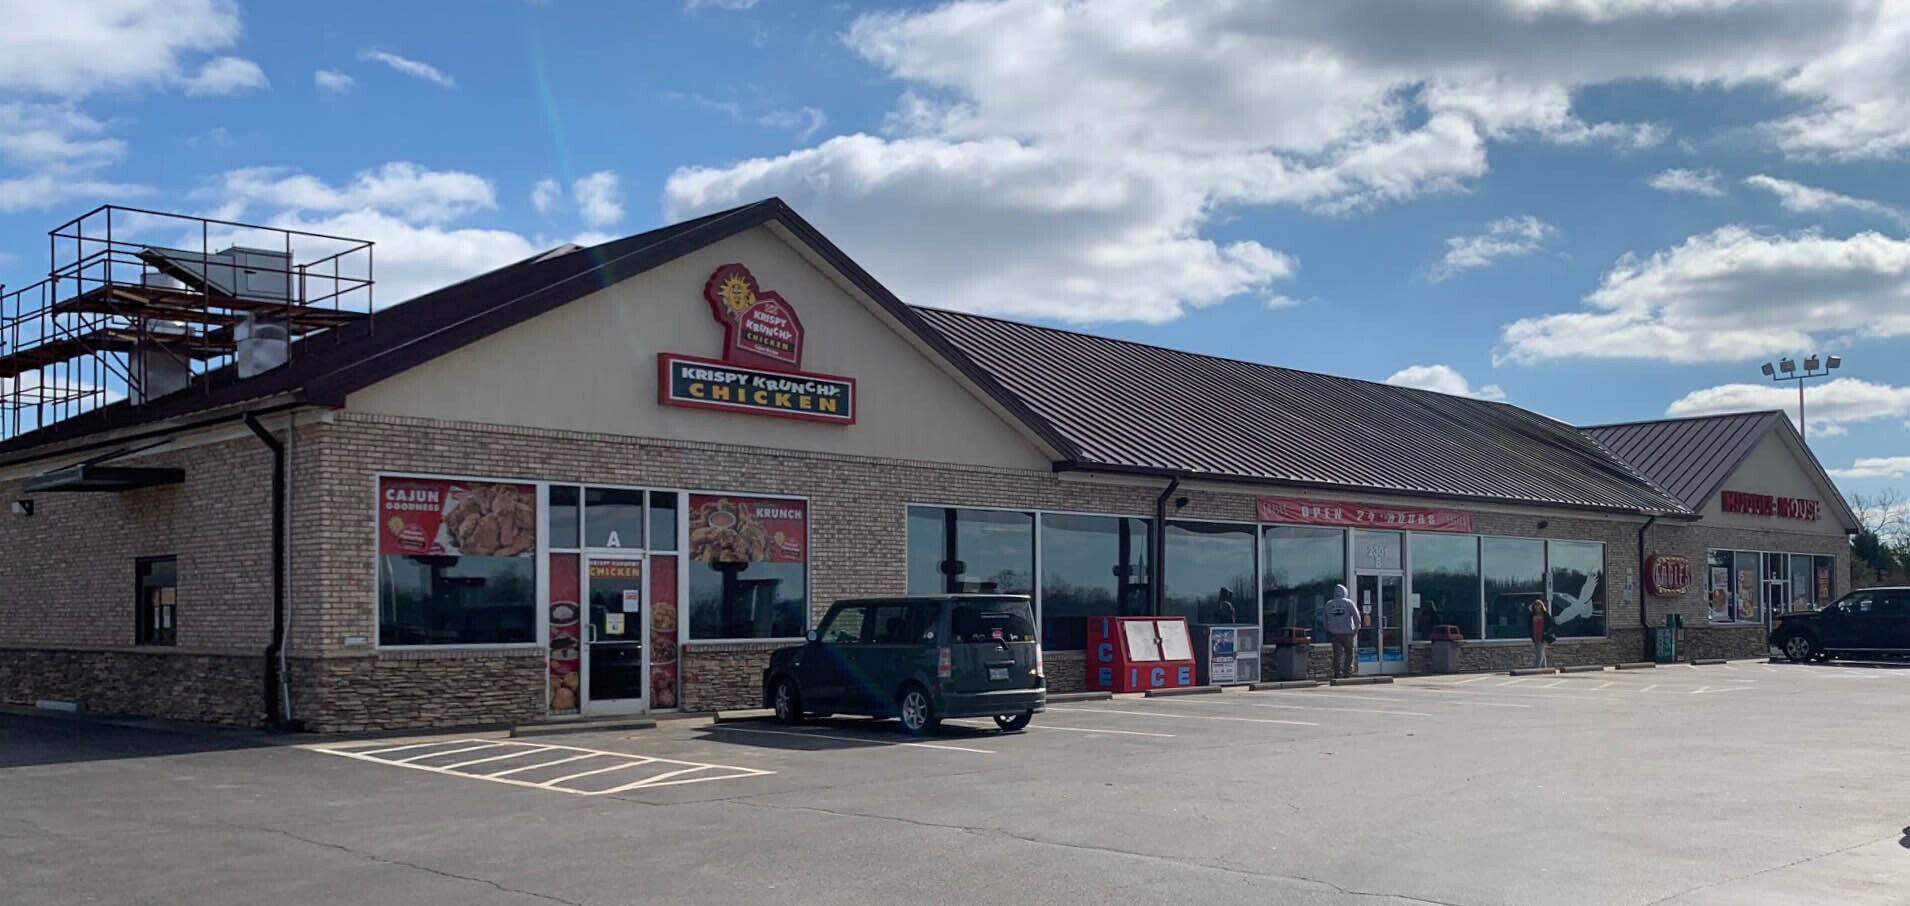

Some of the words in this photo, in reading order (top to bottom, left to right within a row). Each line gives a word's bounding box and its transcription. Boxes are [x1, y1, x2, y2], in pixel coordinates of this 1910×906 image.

[754, 310, 787, 327] KRISPY
[746, 320, 792, 340] KRUNCHY
[747, 333, 790, 350] CHICKEN
[681, 367, 749, 386] KRISPY
[752, 375, 840, 397] KRUNCHY
[689, 383, 836, 412] CHICKEN
[385, 489, 439, 502] CAJUN
[385, 501, 440, 512] GOODNESS
[756, 508, 802, 519] KRUNCH
[1301, 506, 1342, 520] OPEN
[1356, 510, 1375, 522] 24
[606, 530, 621, 547] A
[590, 567, 640, 577] CHICKEN
[1098, 618, 1112, 687] ICE
[1131, 667, 1190, 688] ICE
